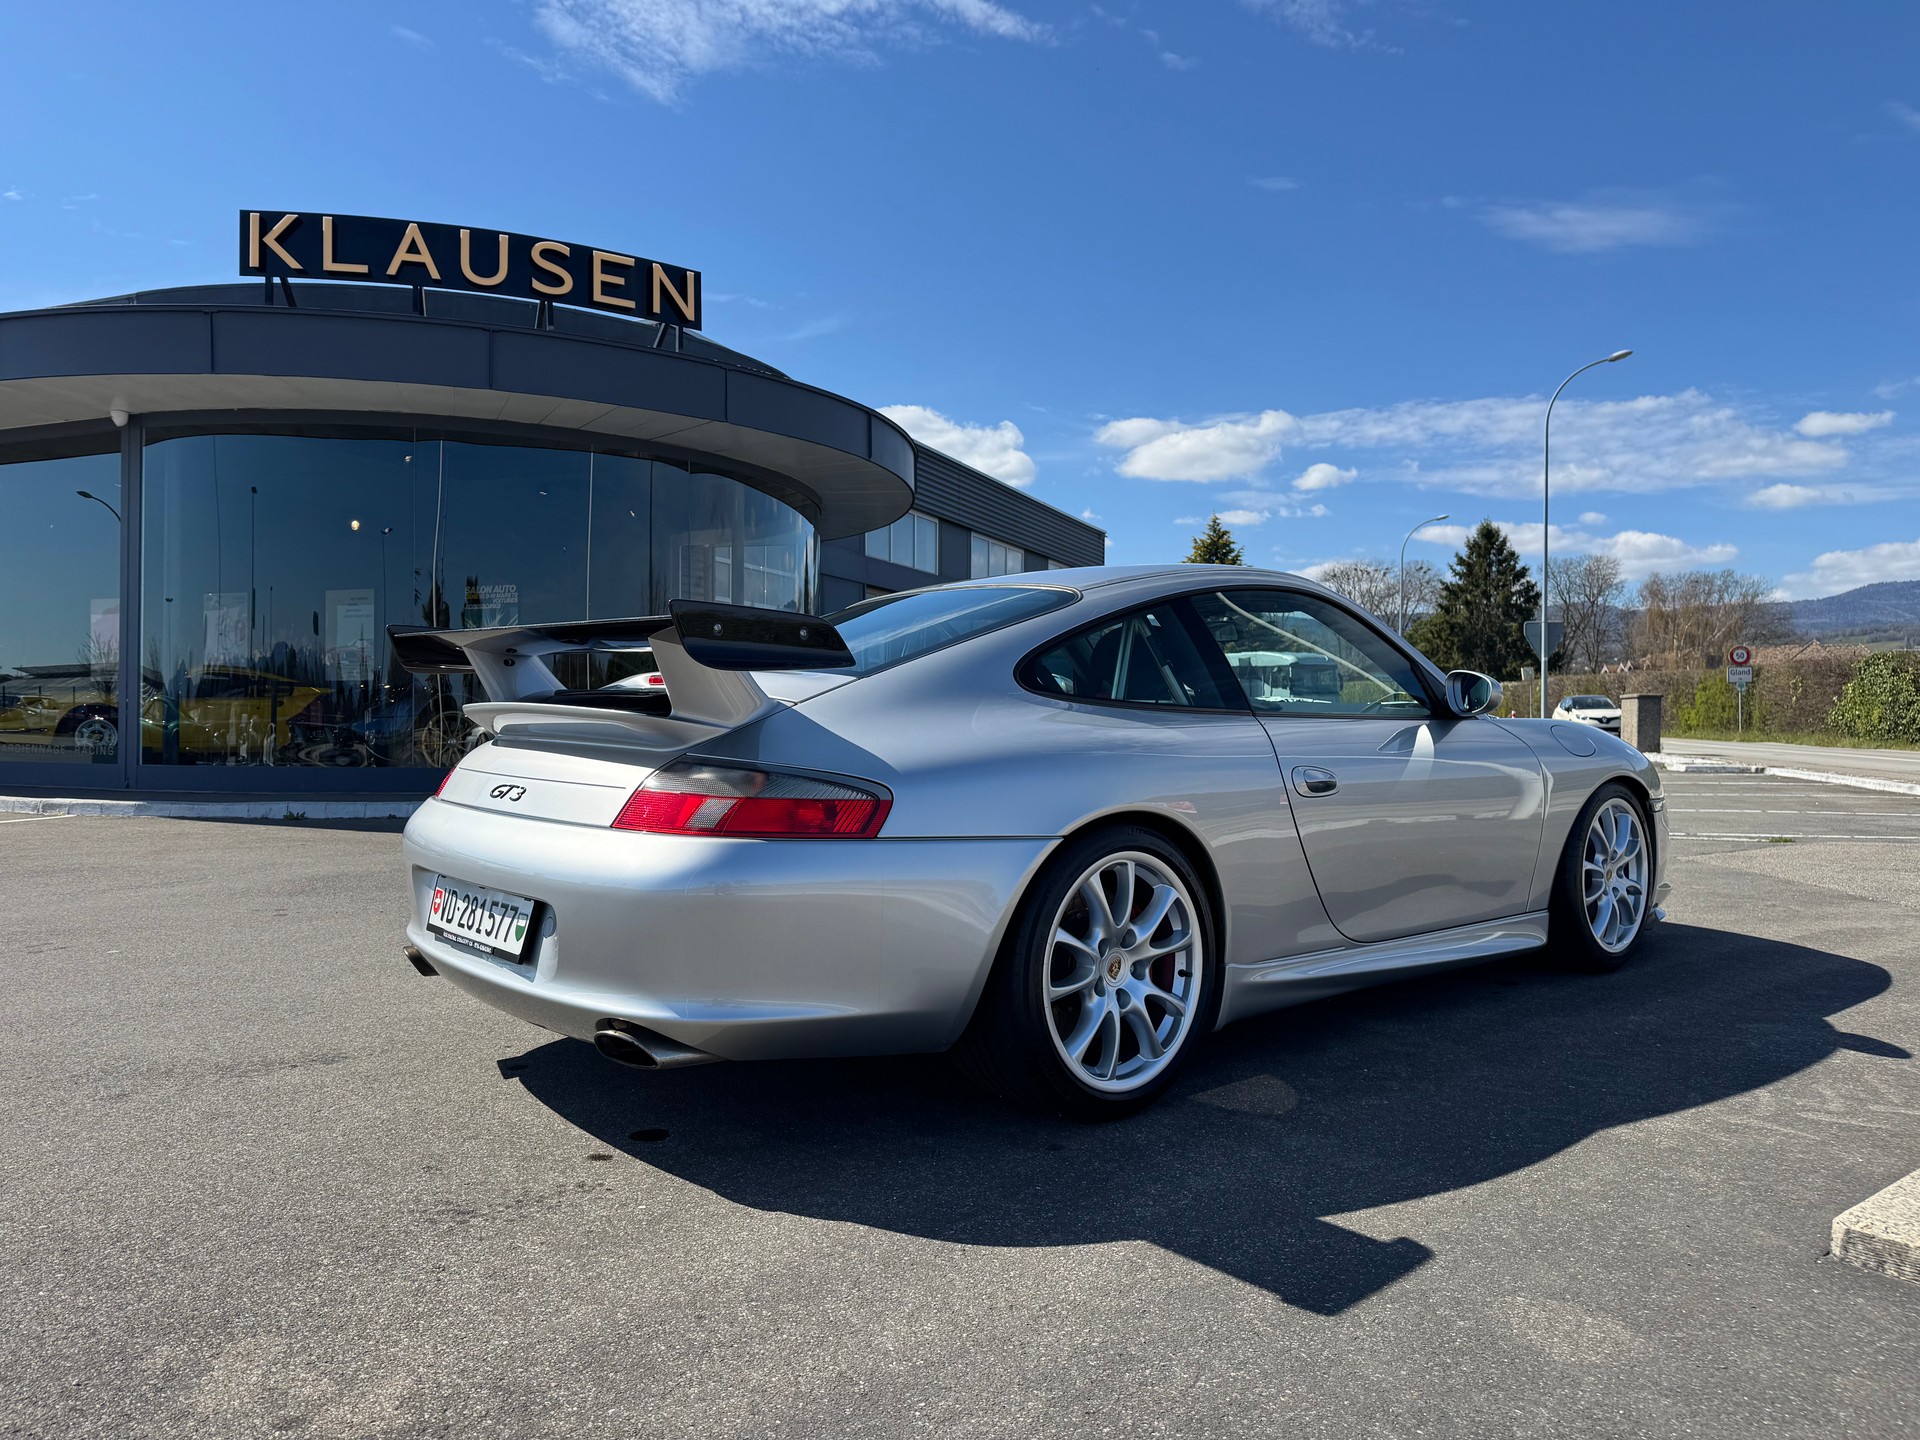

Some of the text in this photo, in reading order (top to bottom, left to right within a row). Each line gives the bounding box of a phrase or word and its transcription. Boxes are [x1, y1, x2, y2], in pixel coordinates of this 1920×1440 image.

[248, 211, 696, 322] KLAUSEN
[465, 584, 516, 593] SALON AUTO
[1736, 652, 1745, 660] 50
[0, 743, 114, 756] ARDIENNAGE RACING
[489, 784, 527, 802] GT3
